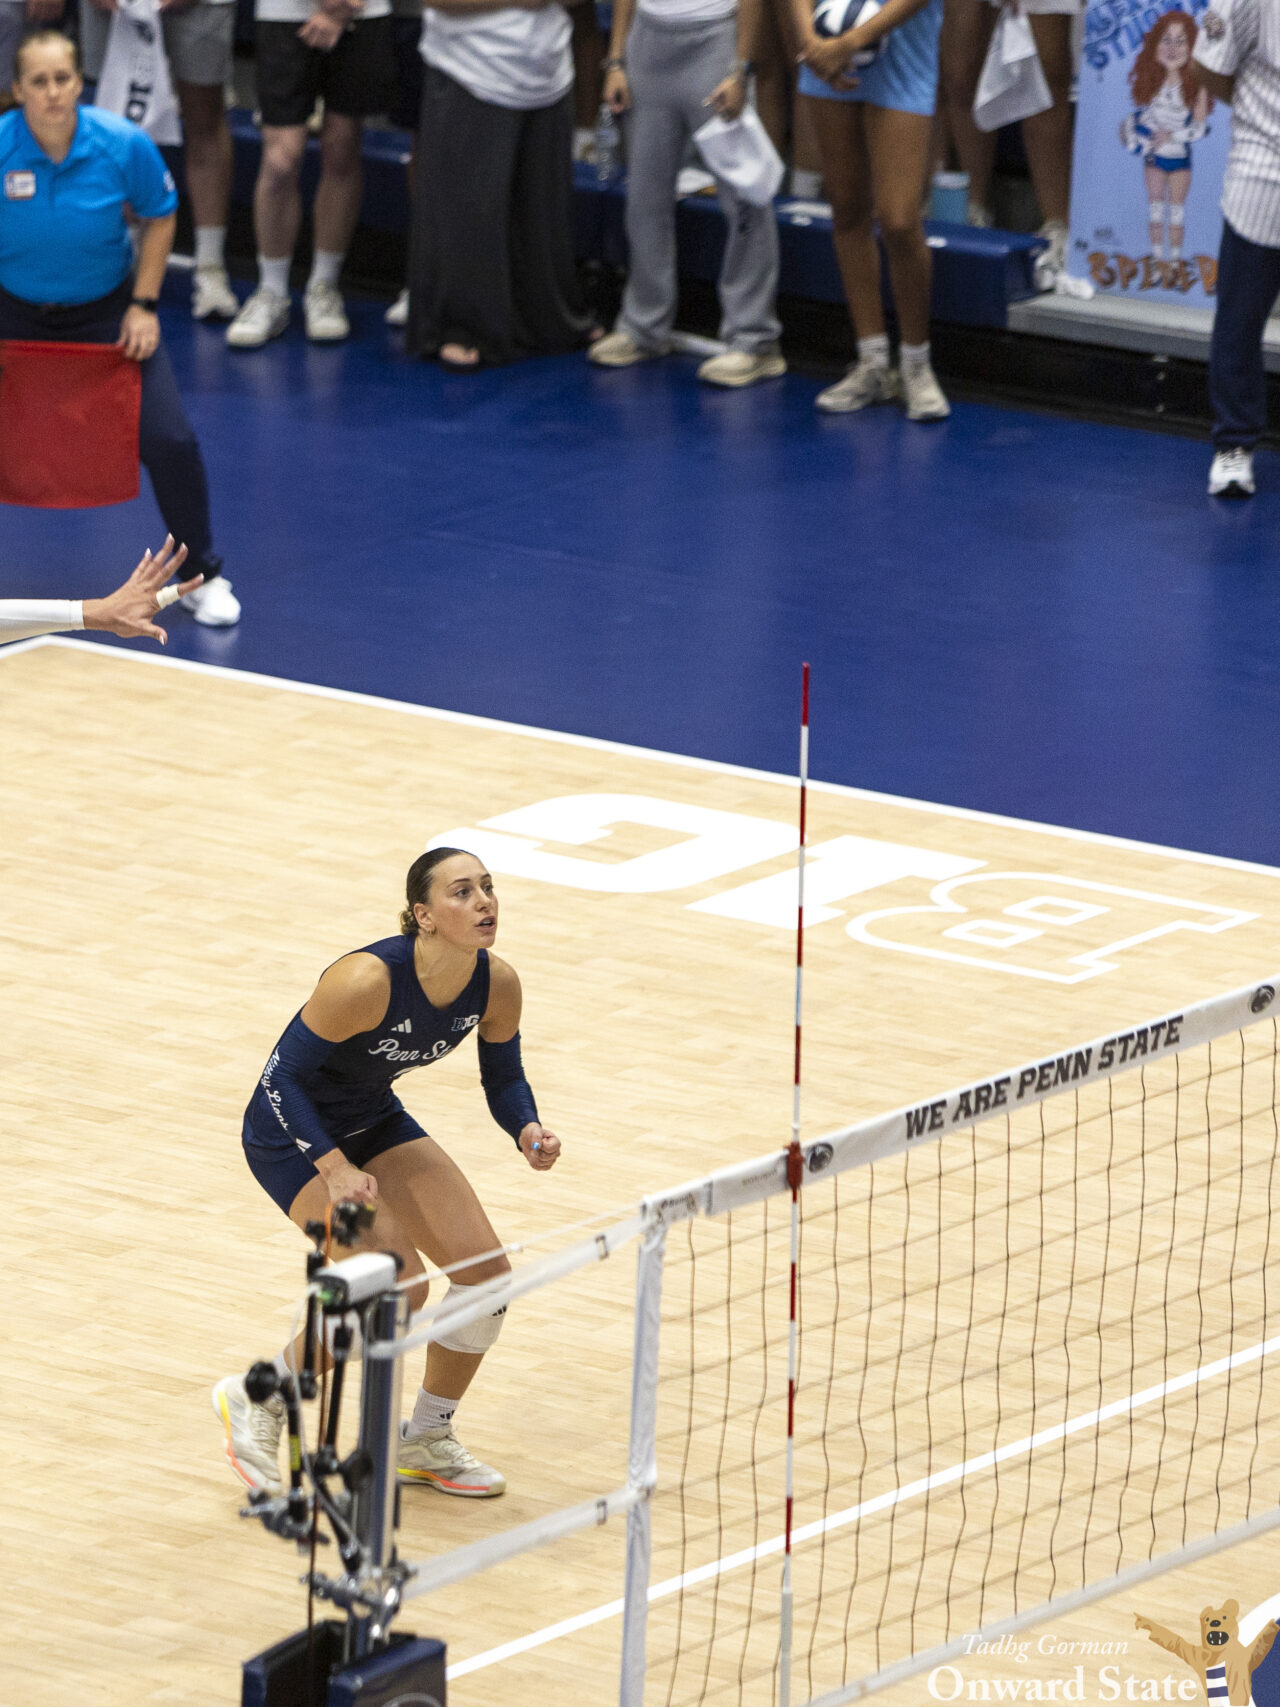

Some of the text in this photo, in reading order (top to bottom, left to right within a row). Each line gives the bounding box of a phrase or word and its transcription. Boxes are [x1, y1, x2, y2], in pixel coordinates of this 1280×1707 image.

[368, 1038, 420, 1061] Penn
[905, 1014, 1184, 1140] WE ARE PENN STATE
